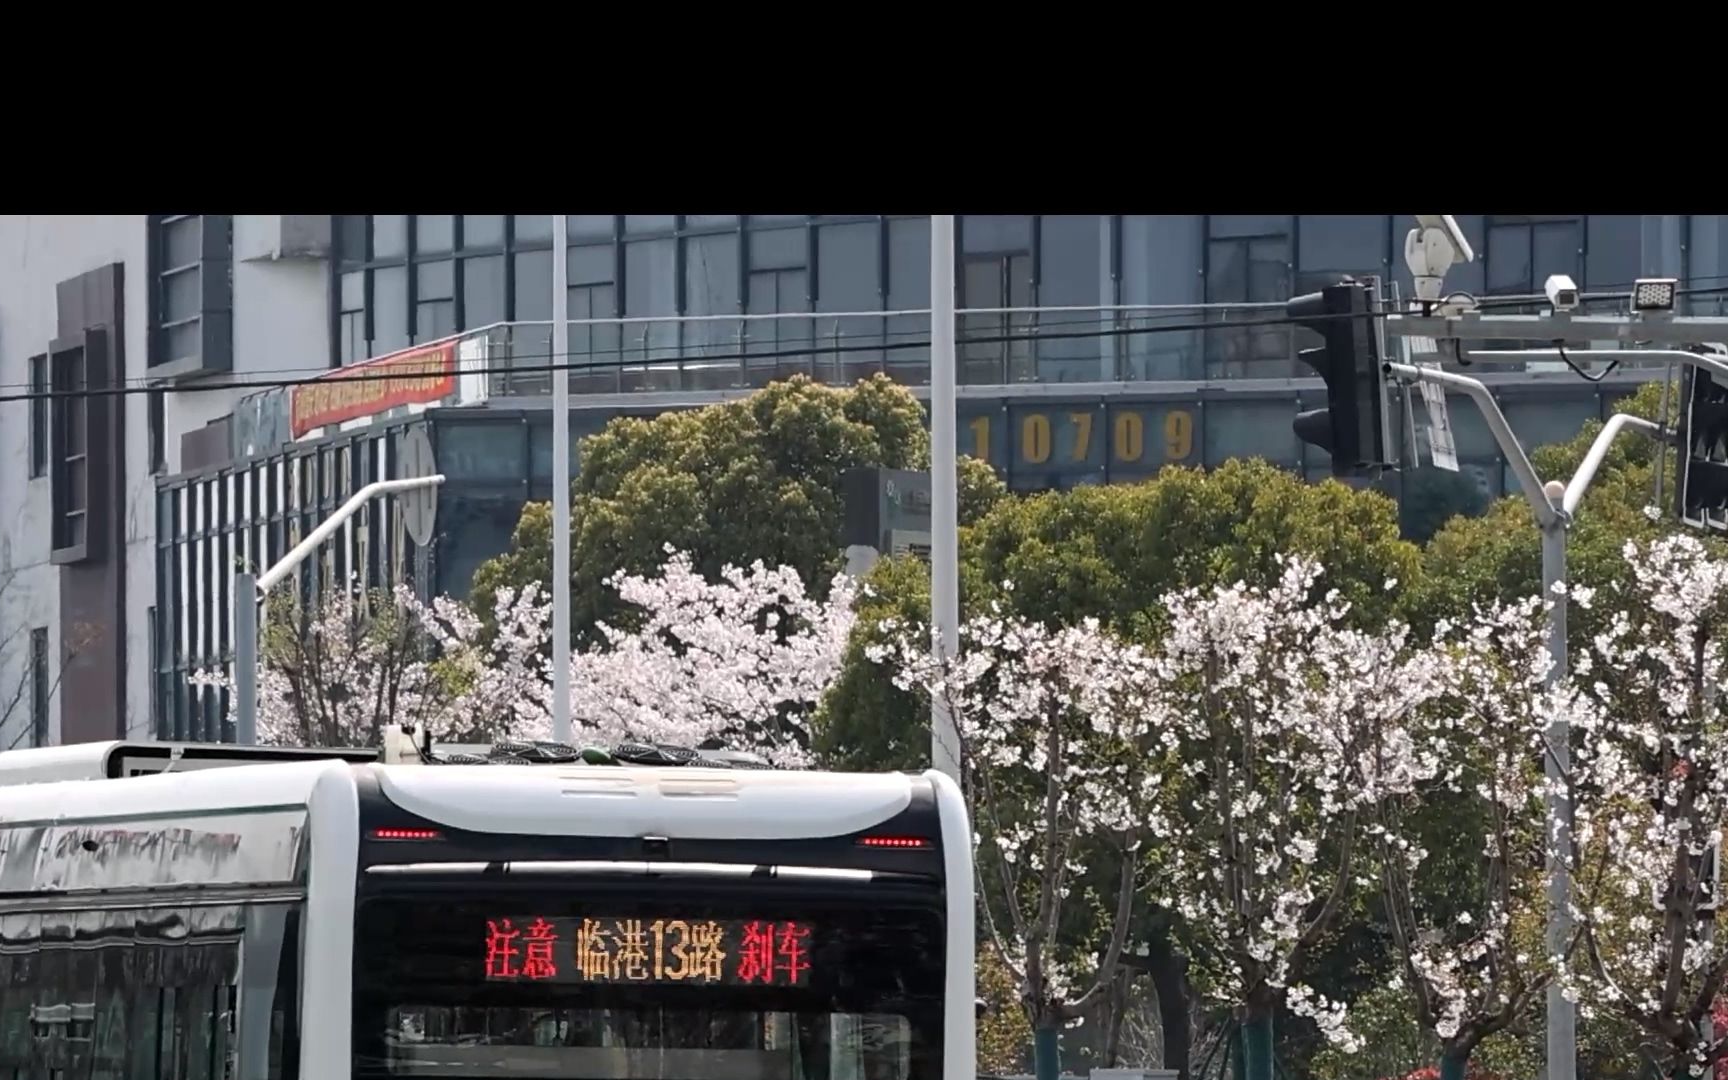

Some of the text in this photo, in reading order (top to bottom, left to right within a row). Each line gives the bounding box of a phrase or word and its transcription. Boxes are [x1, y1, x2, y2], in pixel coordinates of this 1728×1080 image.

[969, 410, 1193, 464] 10709
[484, 916, 813, 984] 注意 临港13路 刹车
